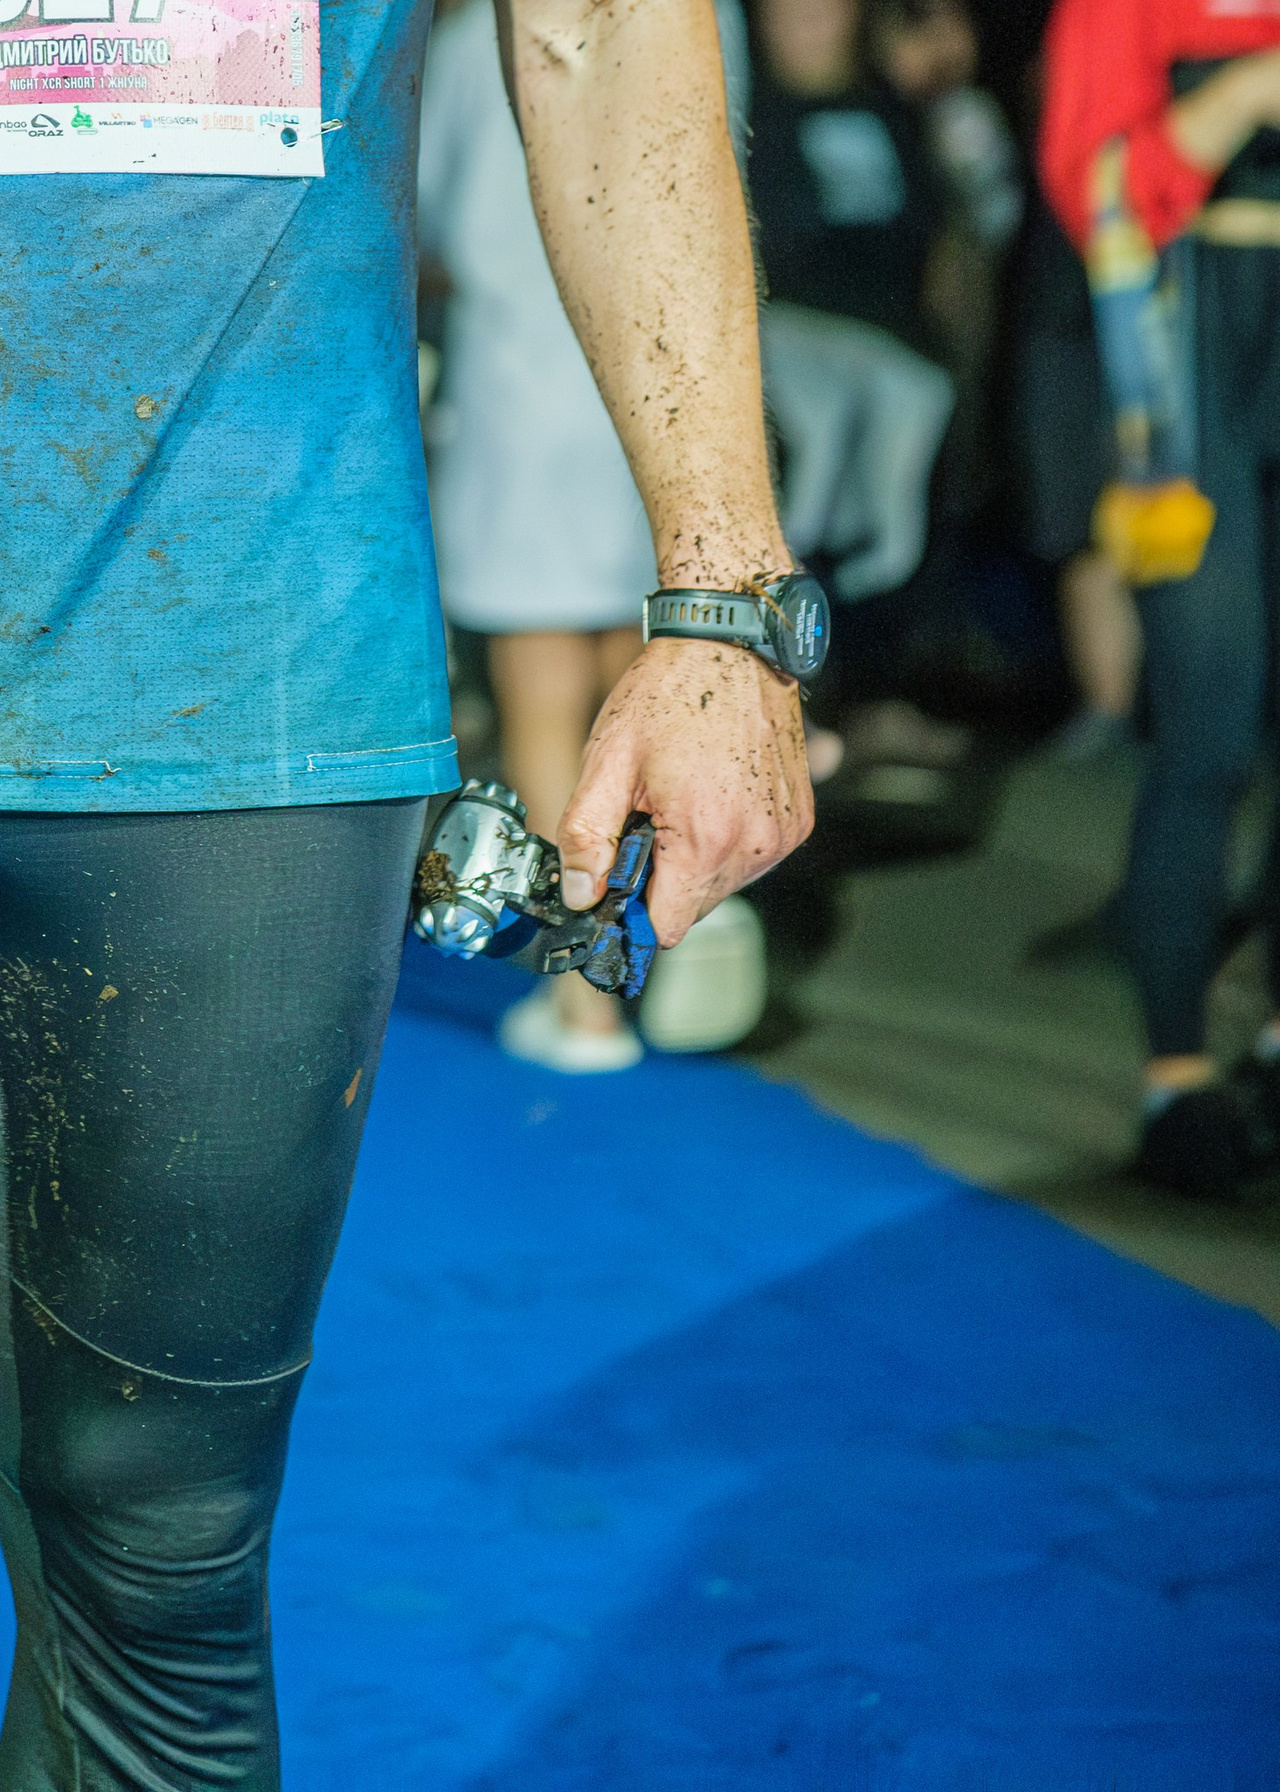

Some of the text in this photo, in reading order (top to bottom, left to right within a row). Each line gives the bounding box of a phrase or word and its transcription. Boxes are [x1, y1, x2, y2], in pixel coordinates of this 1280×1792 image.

[91, 37, 170, 65] БУТЬКО
[10, 78, 39, 91] NIGHT
[64, 77, 96, 90] SHORT
[99, 77, 105, 89] 1
[28, 130, 64, 138] ORAZ
